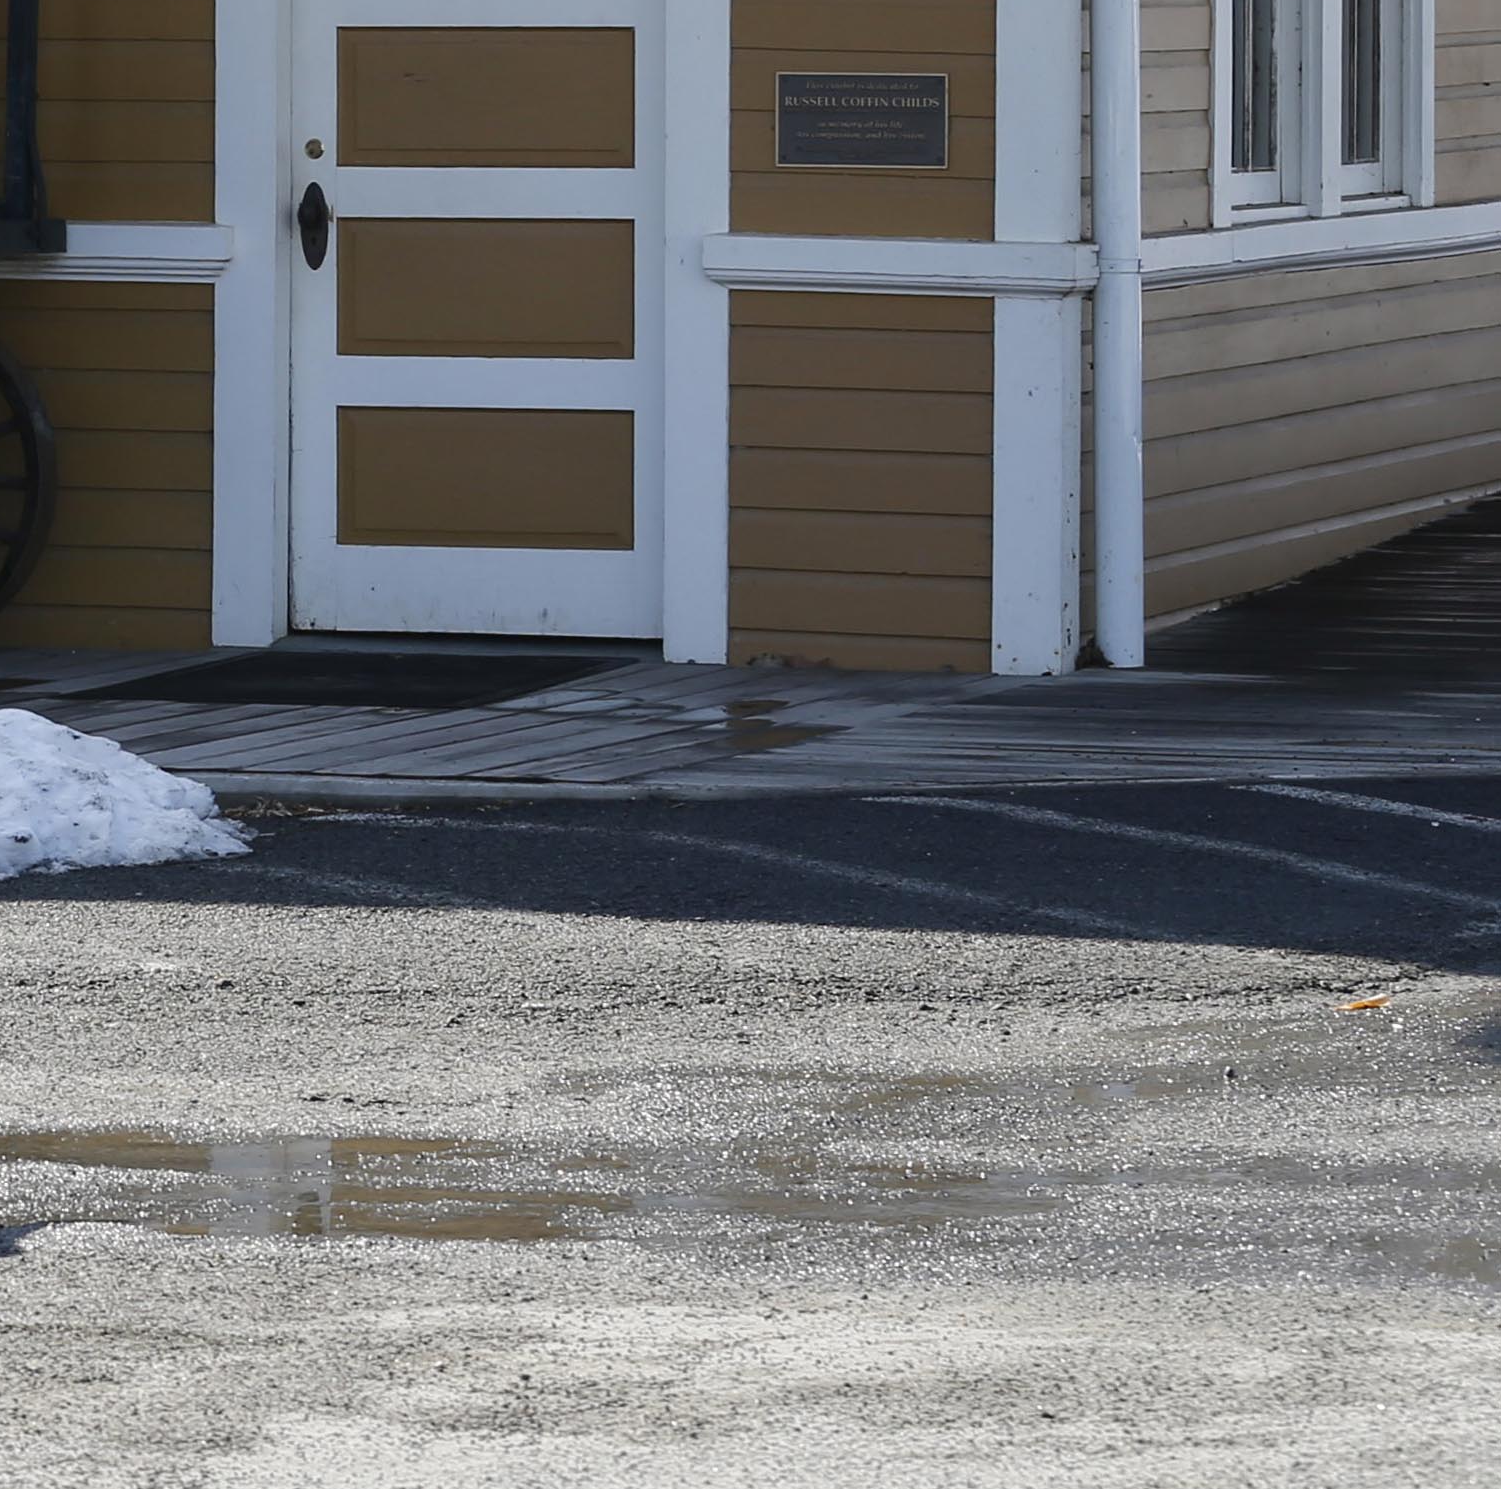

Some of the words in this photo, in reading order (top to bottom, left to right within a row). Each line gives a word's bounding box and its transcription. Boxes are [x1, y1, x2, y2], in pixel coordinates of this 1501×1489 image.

[784, 96, 838, 107] RUSSELL
[841, 96, 888, 108] COFFIN
[890, 96, 940, 108] CHILDS
